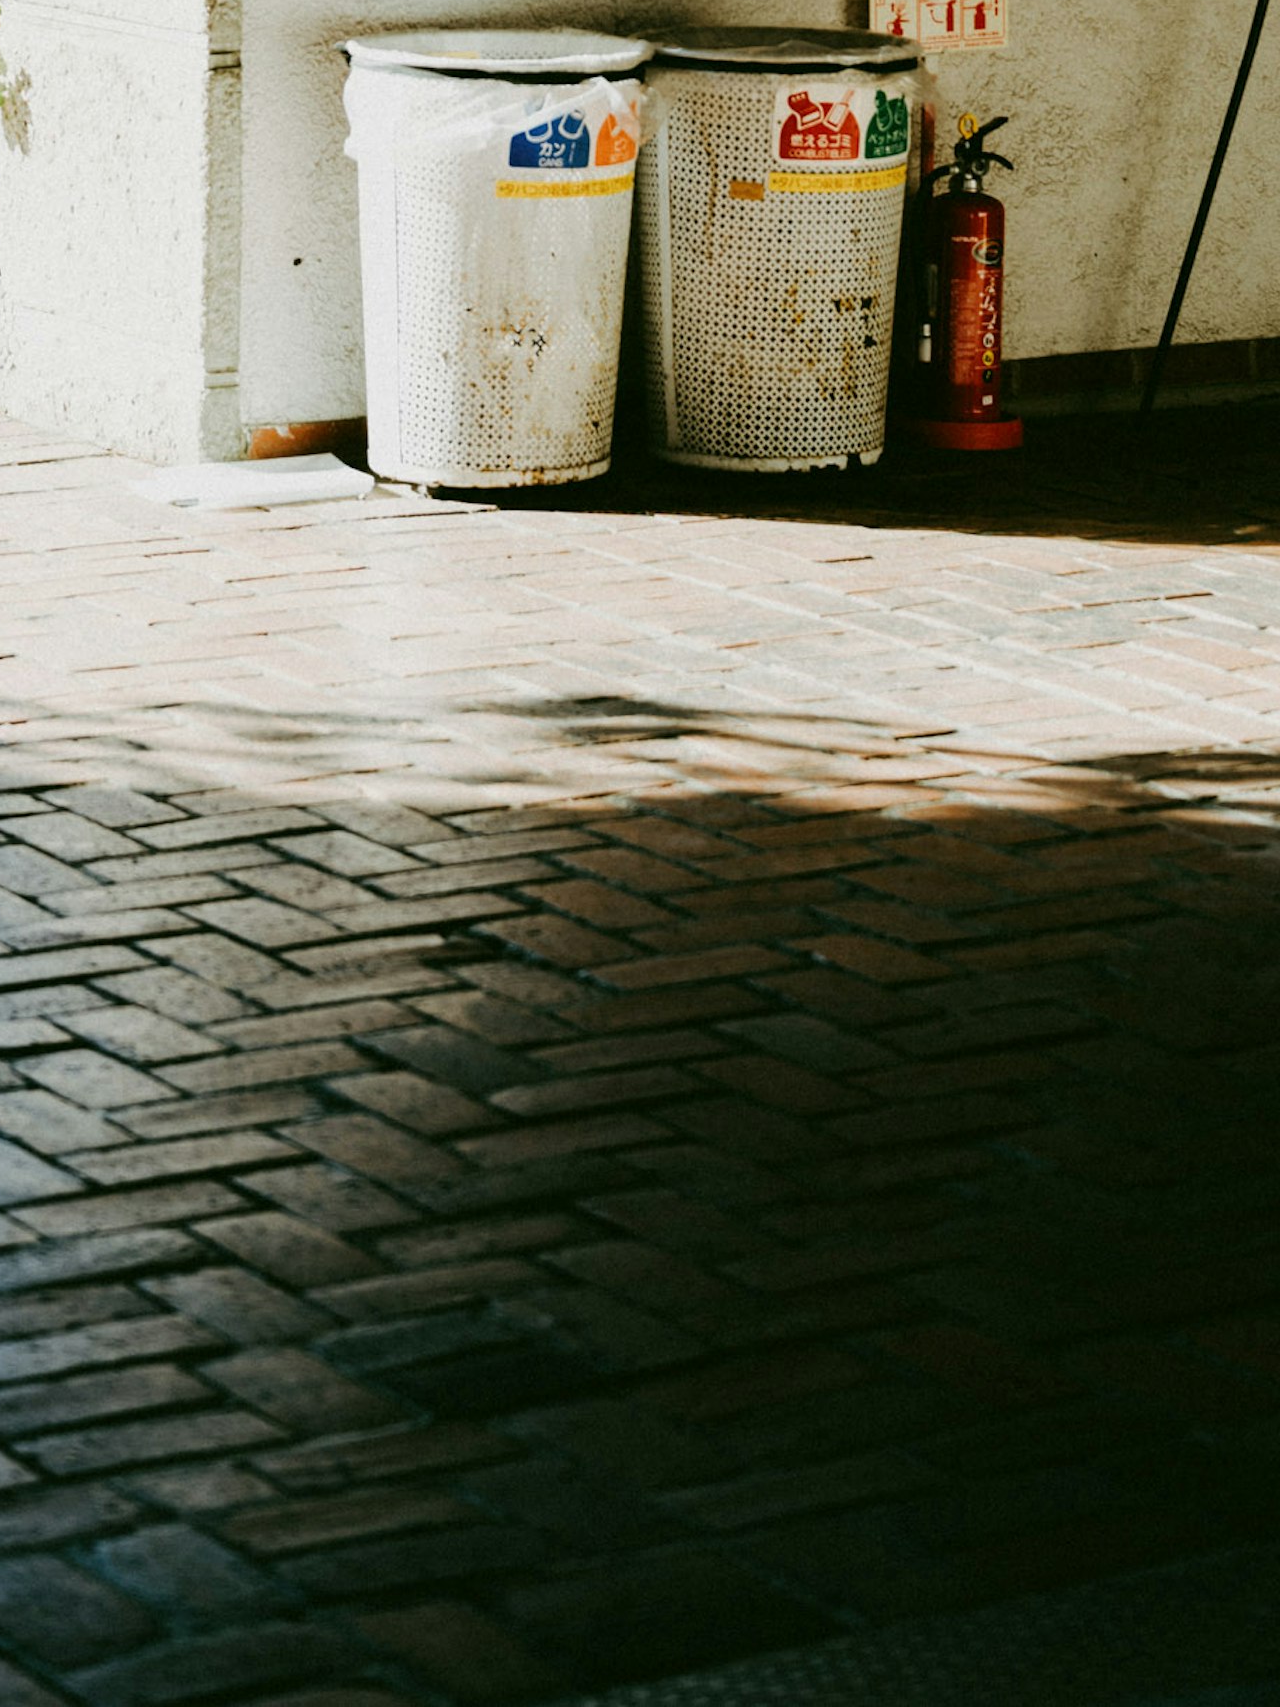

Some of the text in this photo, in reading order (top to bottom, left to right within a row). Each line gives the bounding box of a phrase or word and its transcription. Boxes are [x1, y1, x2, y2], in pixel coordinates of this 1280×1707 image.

[790, 133, 852, 148] 燃えるゴミ
[539, 142, 566, 157] カン
